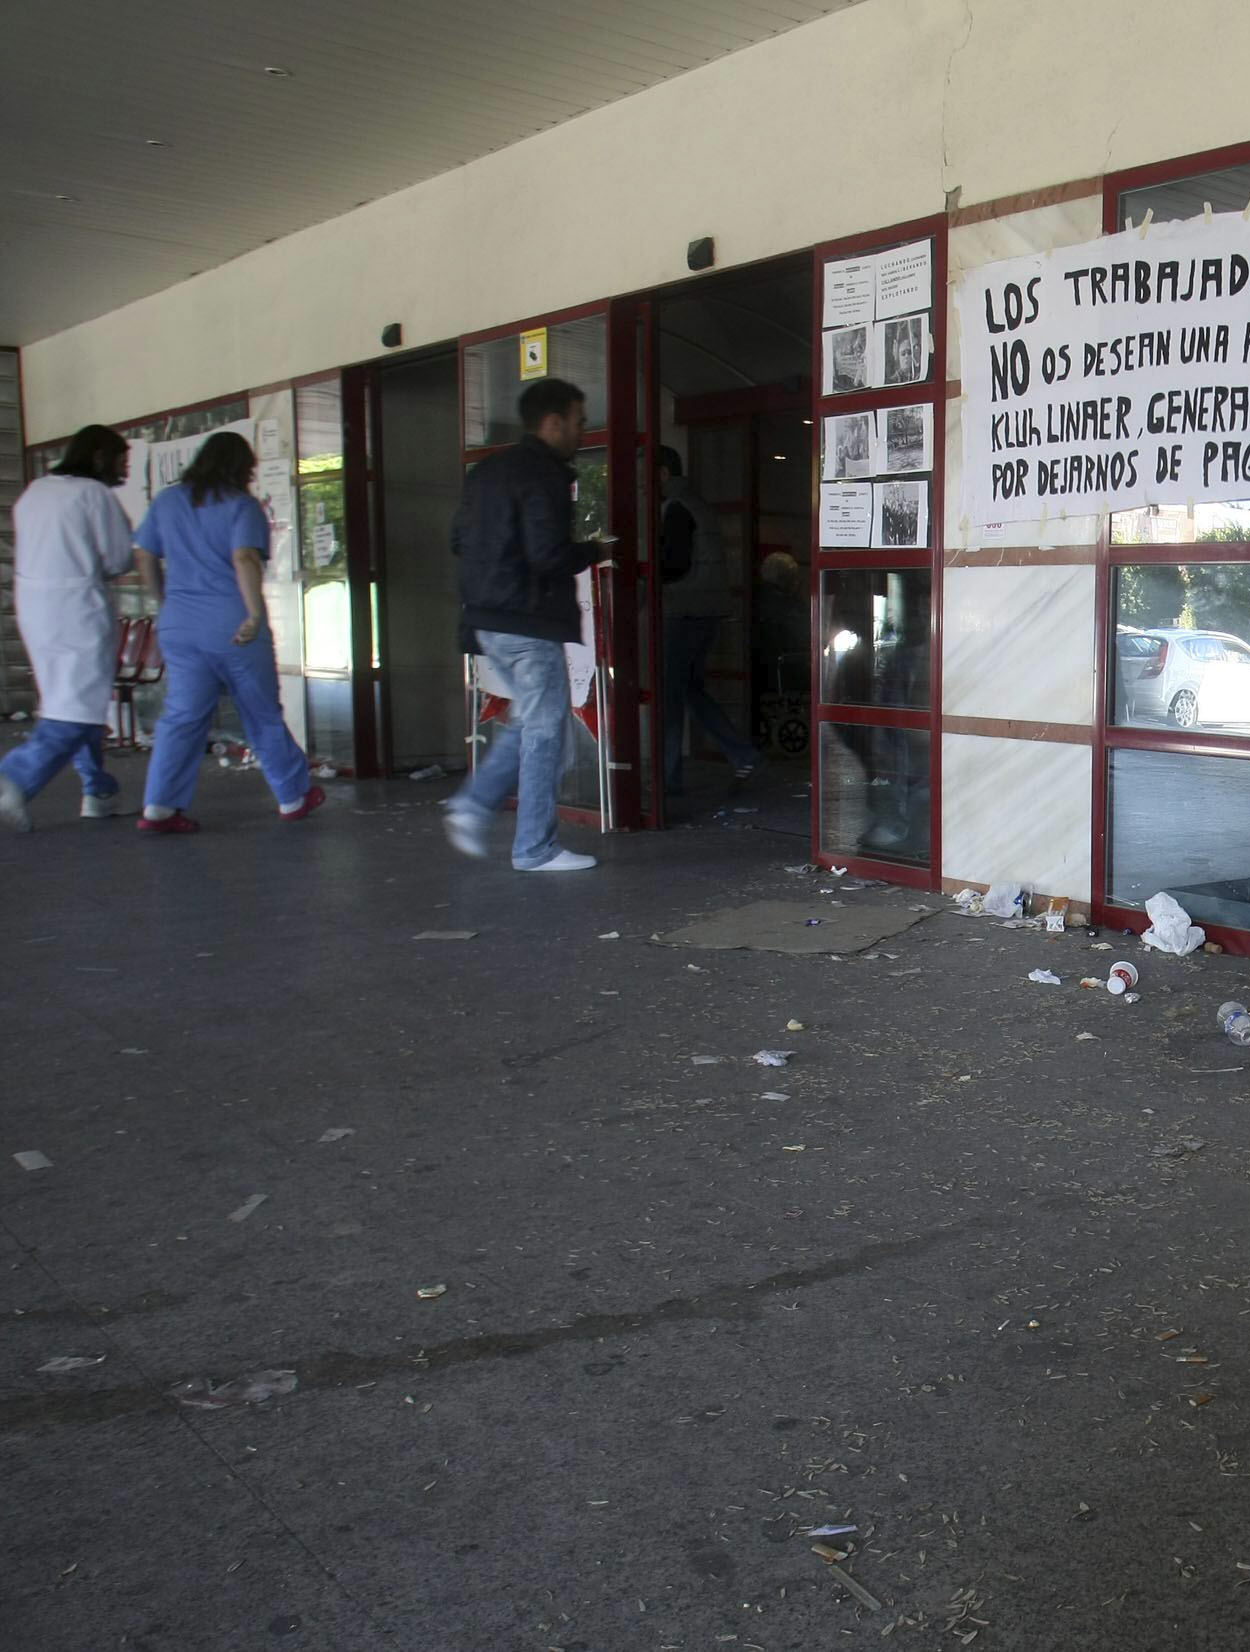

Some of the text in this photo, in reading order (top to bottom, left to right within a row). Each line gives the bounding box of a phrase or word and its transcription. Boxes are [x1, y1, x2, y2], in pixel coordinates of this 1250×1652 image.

[986, 277, 1041, 334] LOS
[990, 338, 1031, 403] NO
[1041, 344, 1071, 385] OS
[1083, 329, 1171, 378] DESEAN
[1180, 324, 1229, 365] UNA
[992, 458, 1029, 502] POR
[1037, 449, 1139, 497] DEJARNOS
[1155, 444, 1183, 484] DE
